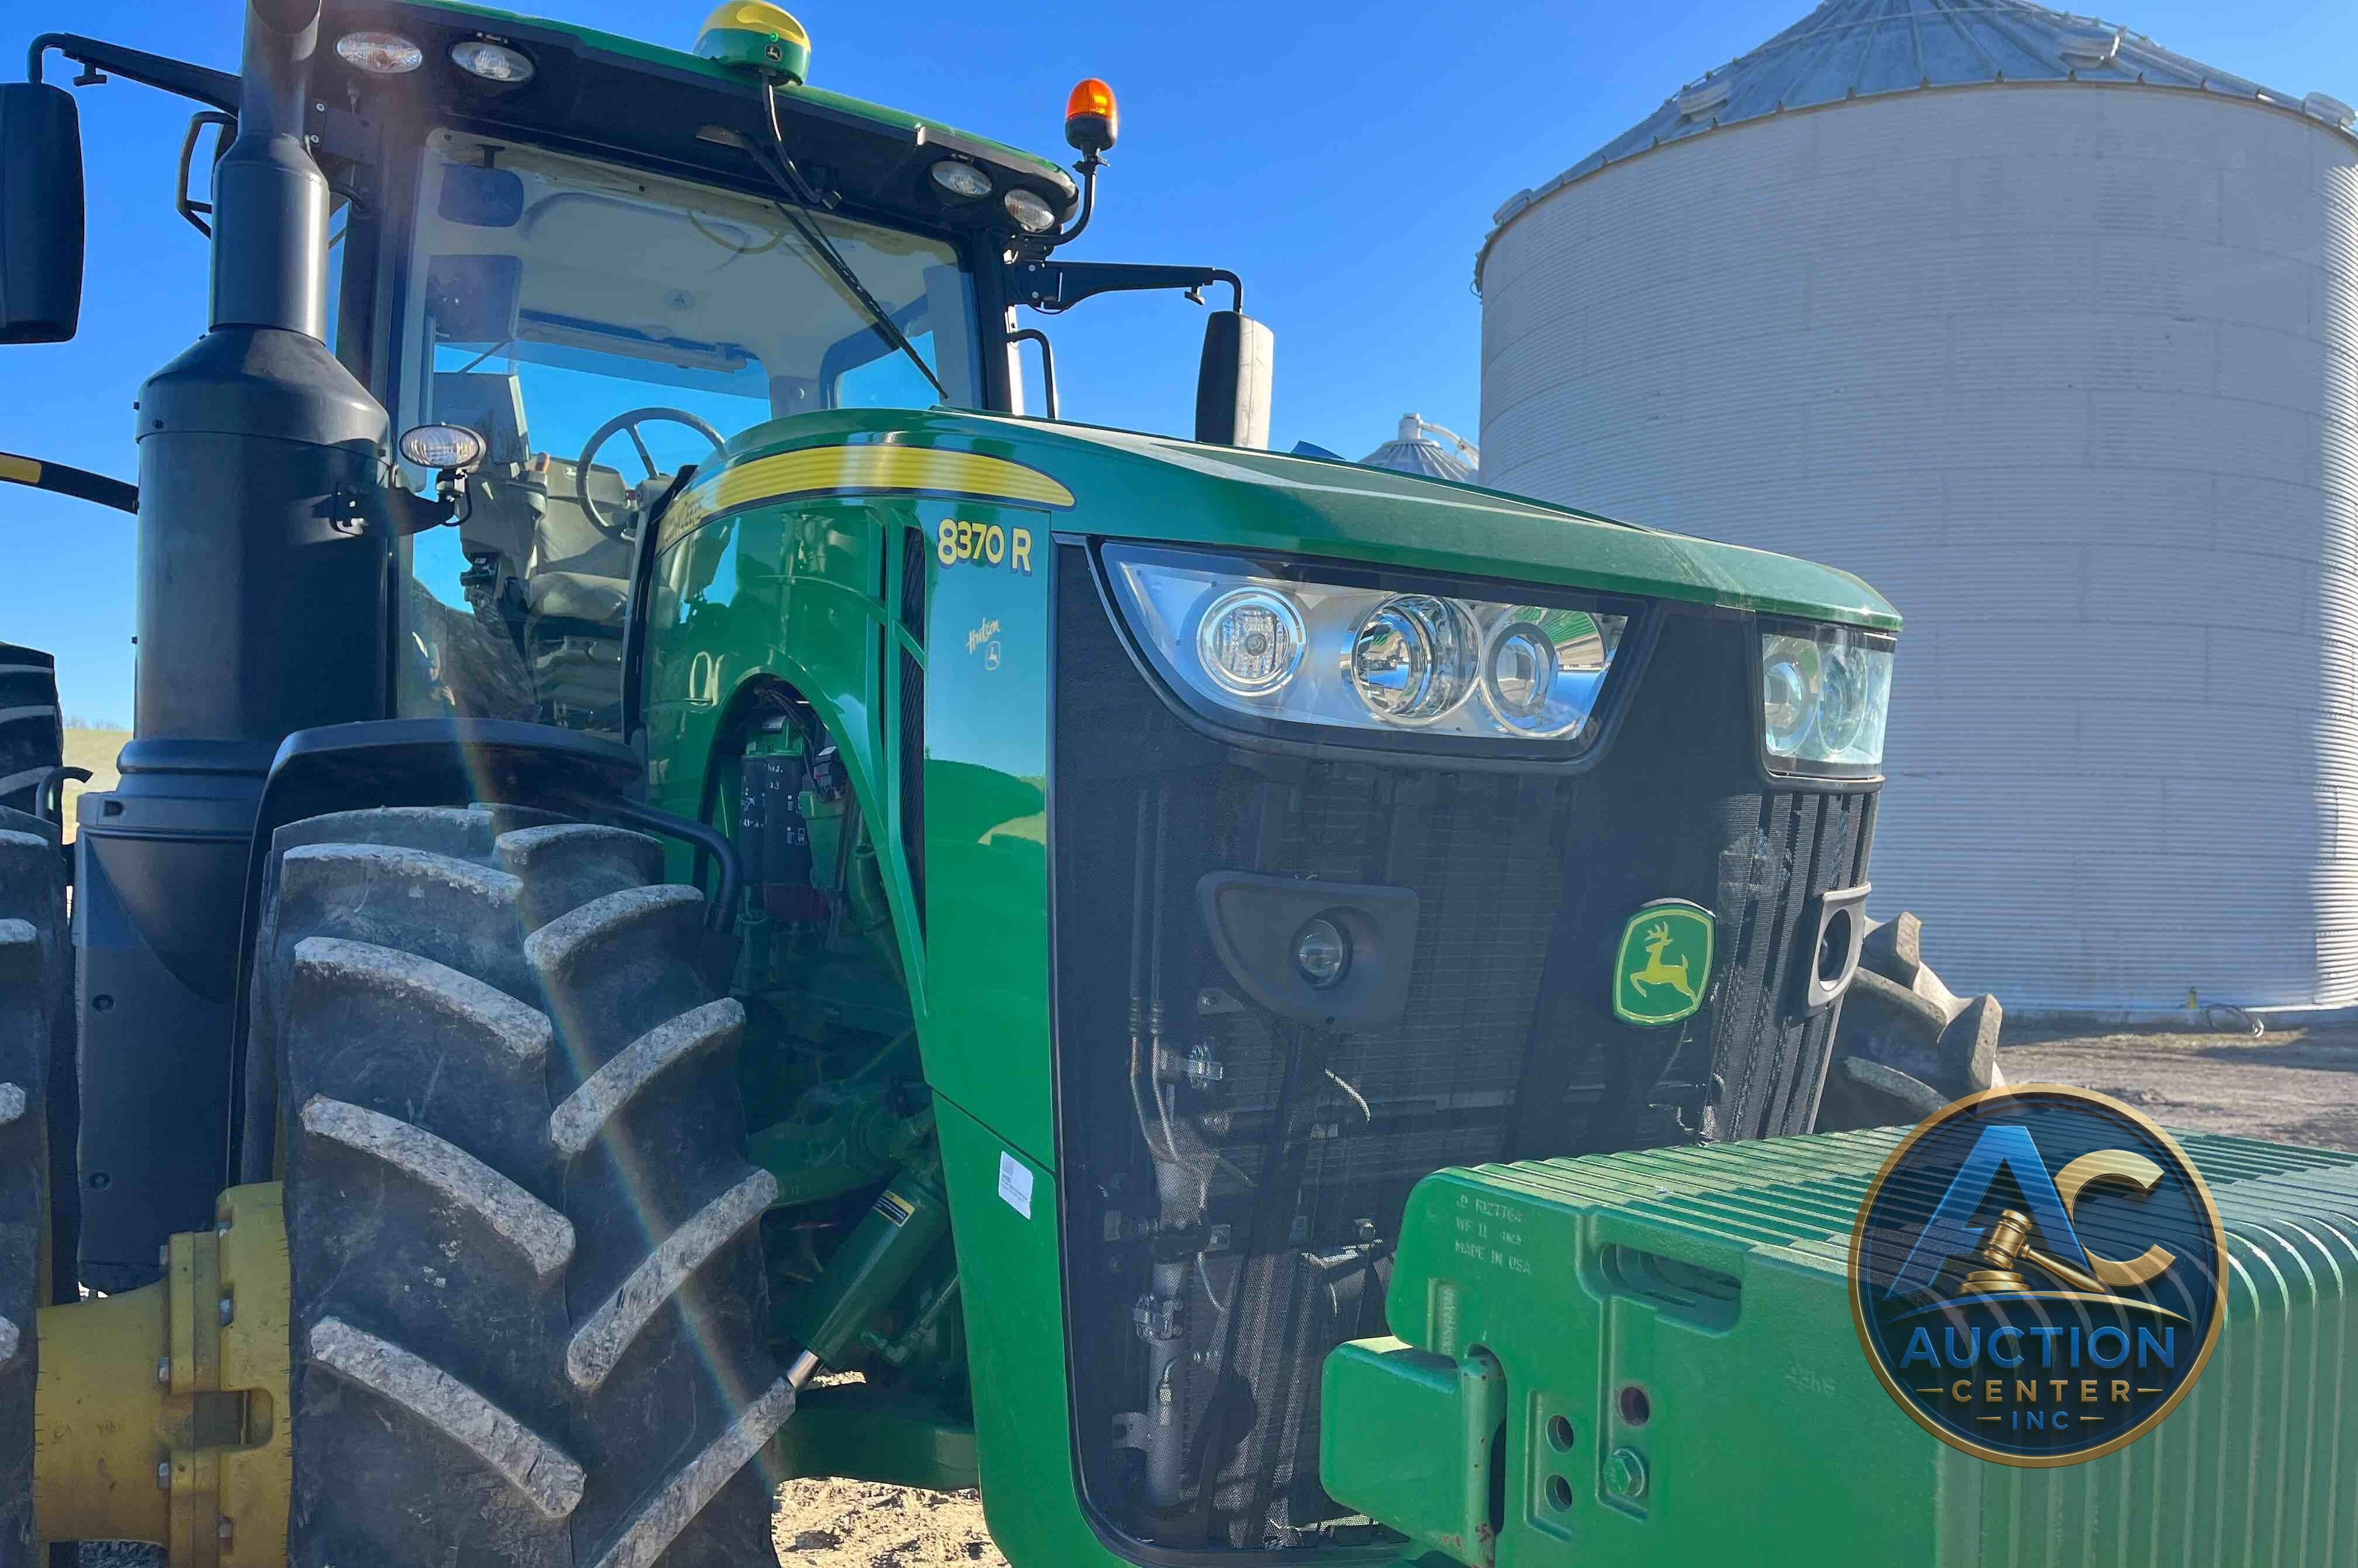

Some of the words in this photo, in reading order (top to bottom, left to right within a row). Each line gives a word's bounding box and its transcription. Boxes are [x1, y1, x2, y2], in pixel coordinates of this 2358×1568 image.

[937, 517, 1005, 568] 8370
[1012, 527, 1033, 575] R
[966, 617, 1001, 655] Hutson
[1454, 1239, 1484, 1260] MADE
[1491, 1249, 1503, 1266] IN
[1508, 1255, 1530, 1275] USA
